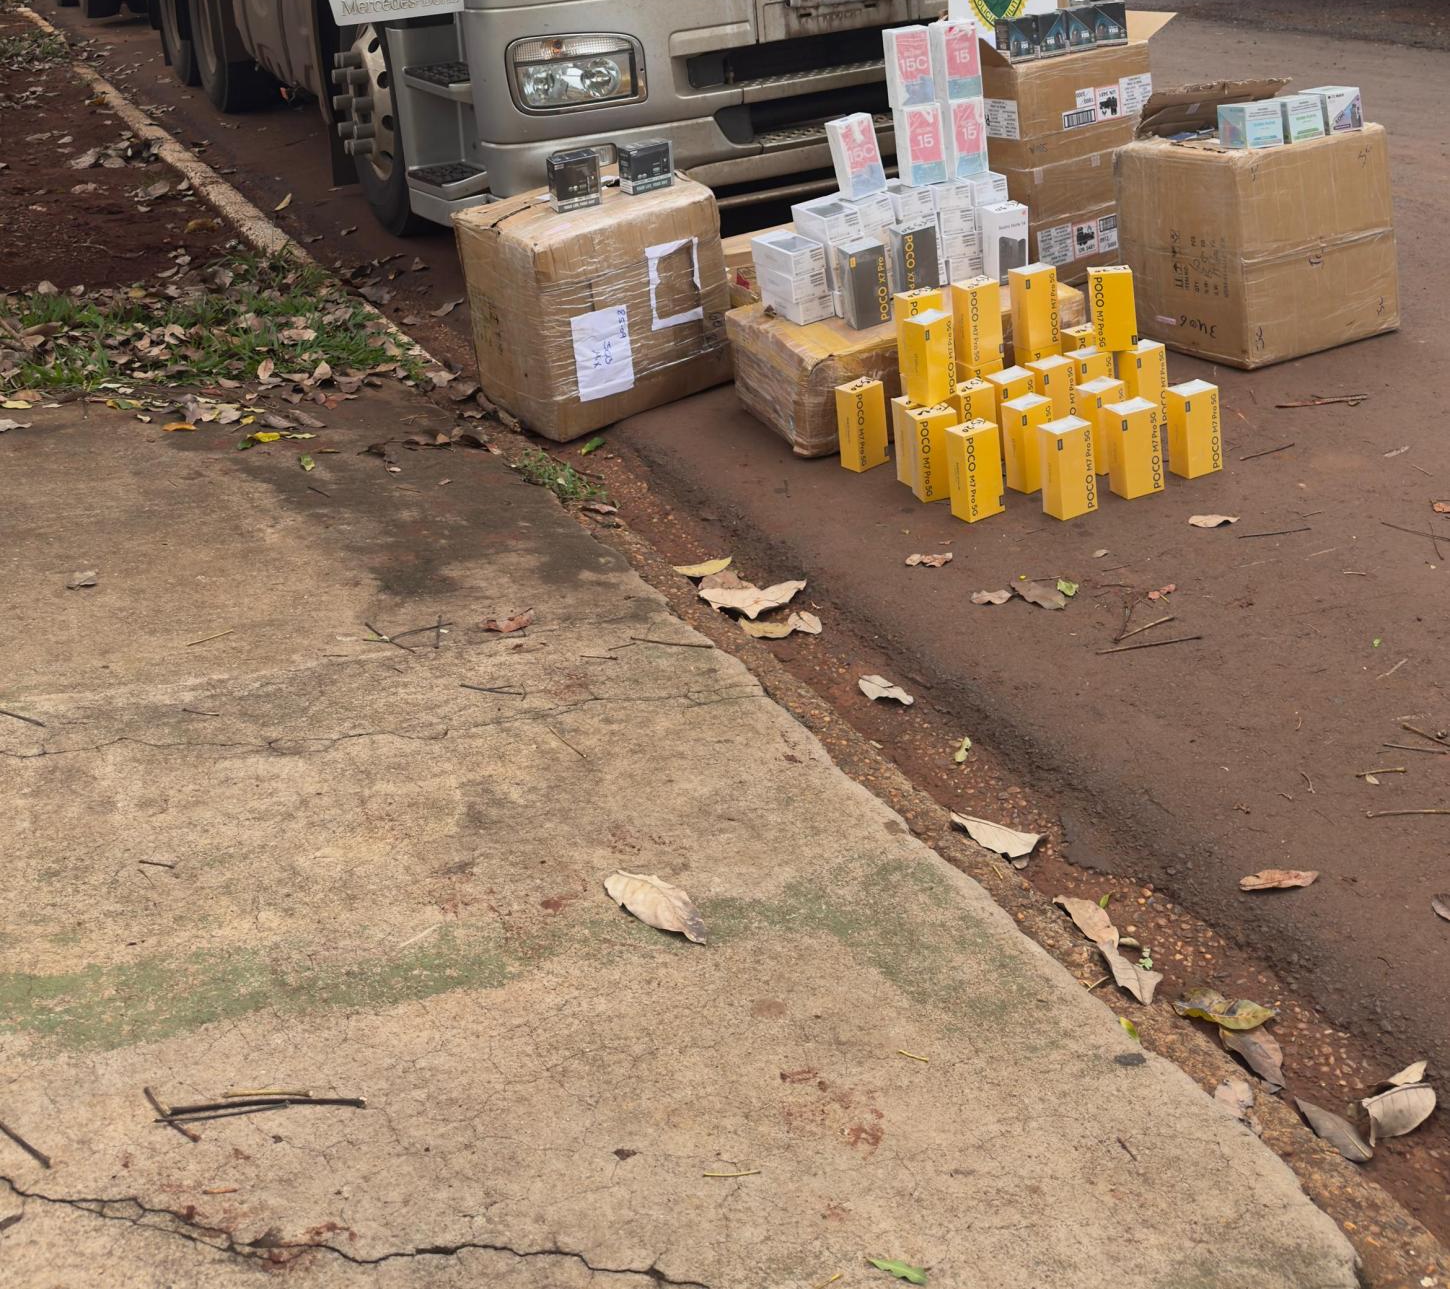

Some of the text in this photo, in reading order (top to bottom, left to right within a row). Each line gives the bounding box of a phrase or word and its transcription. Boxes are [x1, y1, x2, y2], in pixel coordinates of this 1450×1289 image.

[900, 56, 928, 71] 15C
[954, 49, 970, 64] 15
[917, 133, 934, 148] 15
[961, 126, 977, 141] 15
[905, 234, 915, 269] POCO
[1049, 273, 1055, 284] 5G
[1094, 276, 1104, 307] POCO
[878, 286, 889, 321] POCO
[910, 301, 918, 316] PO
[970, 291, 979, 322] POCO
[1051, 298, 1058, 310] M7
[1096, 311, 1104, 322] M7
[1051, 312, 1059, 343] POCO
[1098, 338, 1106, 348] 5G
[973, 352, 980, 362] 5G
[948, 362, 956, 394] POCO
[1067, 367, 1074, 378] 5G
[1210, 393, 1217, 405] 5G
[856, 394, 865, 426] POCO
[963, 396, 973, 422] POC
[858, 428, 865, 440] M7
[1211, 420, 1219, 434] M7
[966, 437, 977, 472] POCO
[1150, 412, 1161, 489] POCO M7 Pro 5G
[1211, 436, 1221, 468] POCO
[860, 456, 868, 466] 5G
[920, 421, 933, 497] POCO M7 Pro 5G
[1083, 430, 1095, 508] POCO M7 Pro 5G
[969, 474, 977, 487] M7
[970, 504, 978, 517] 5G
